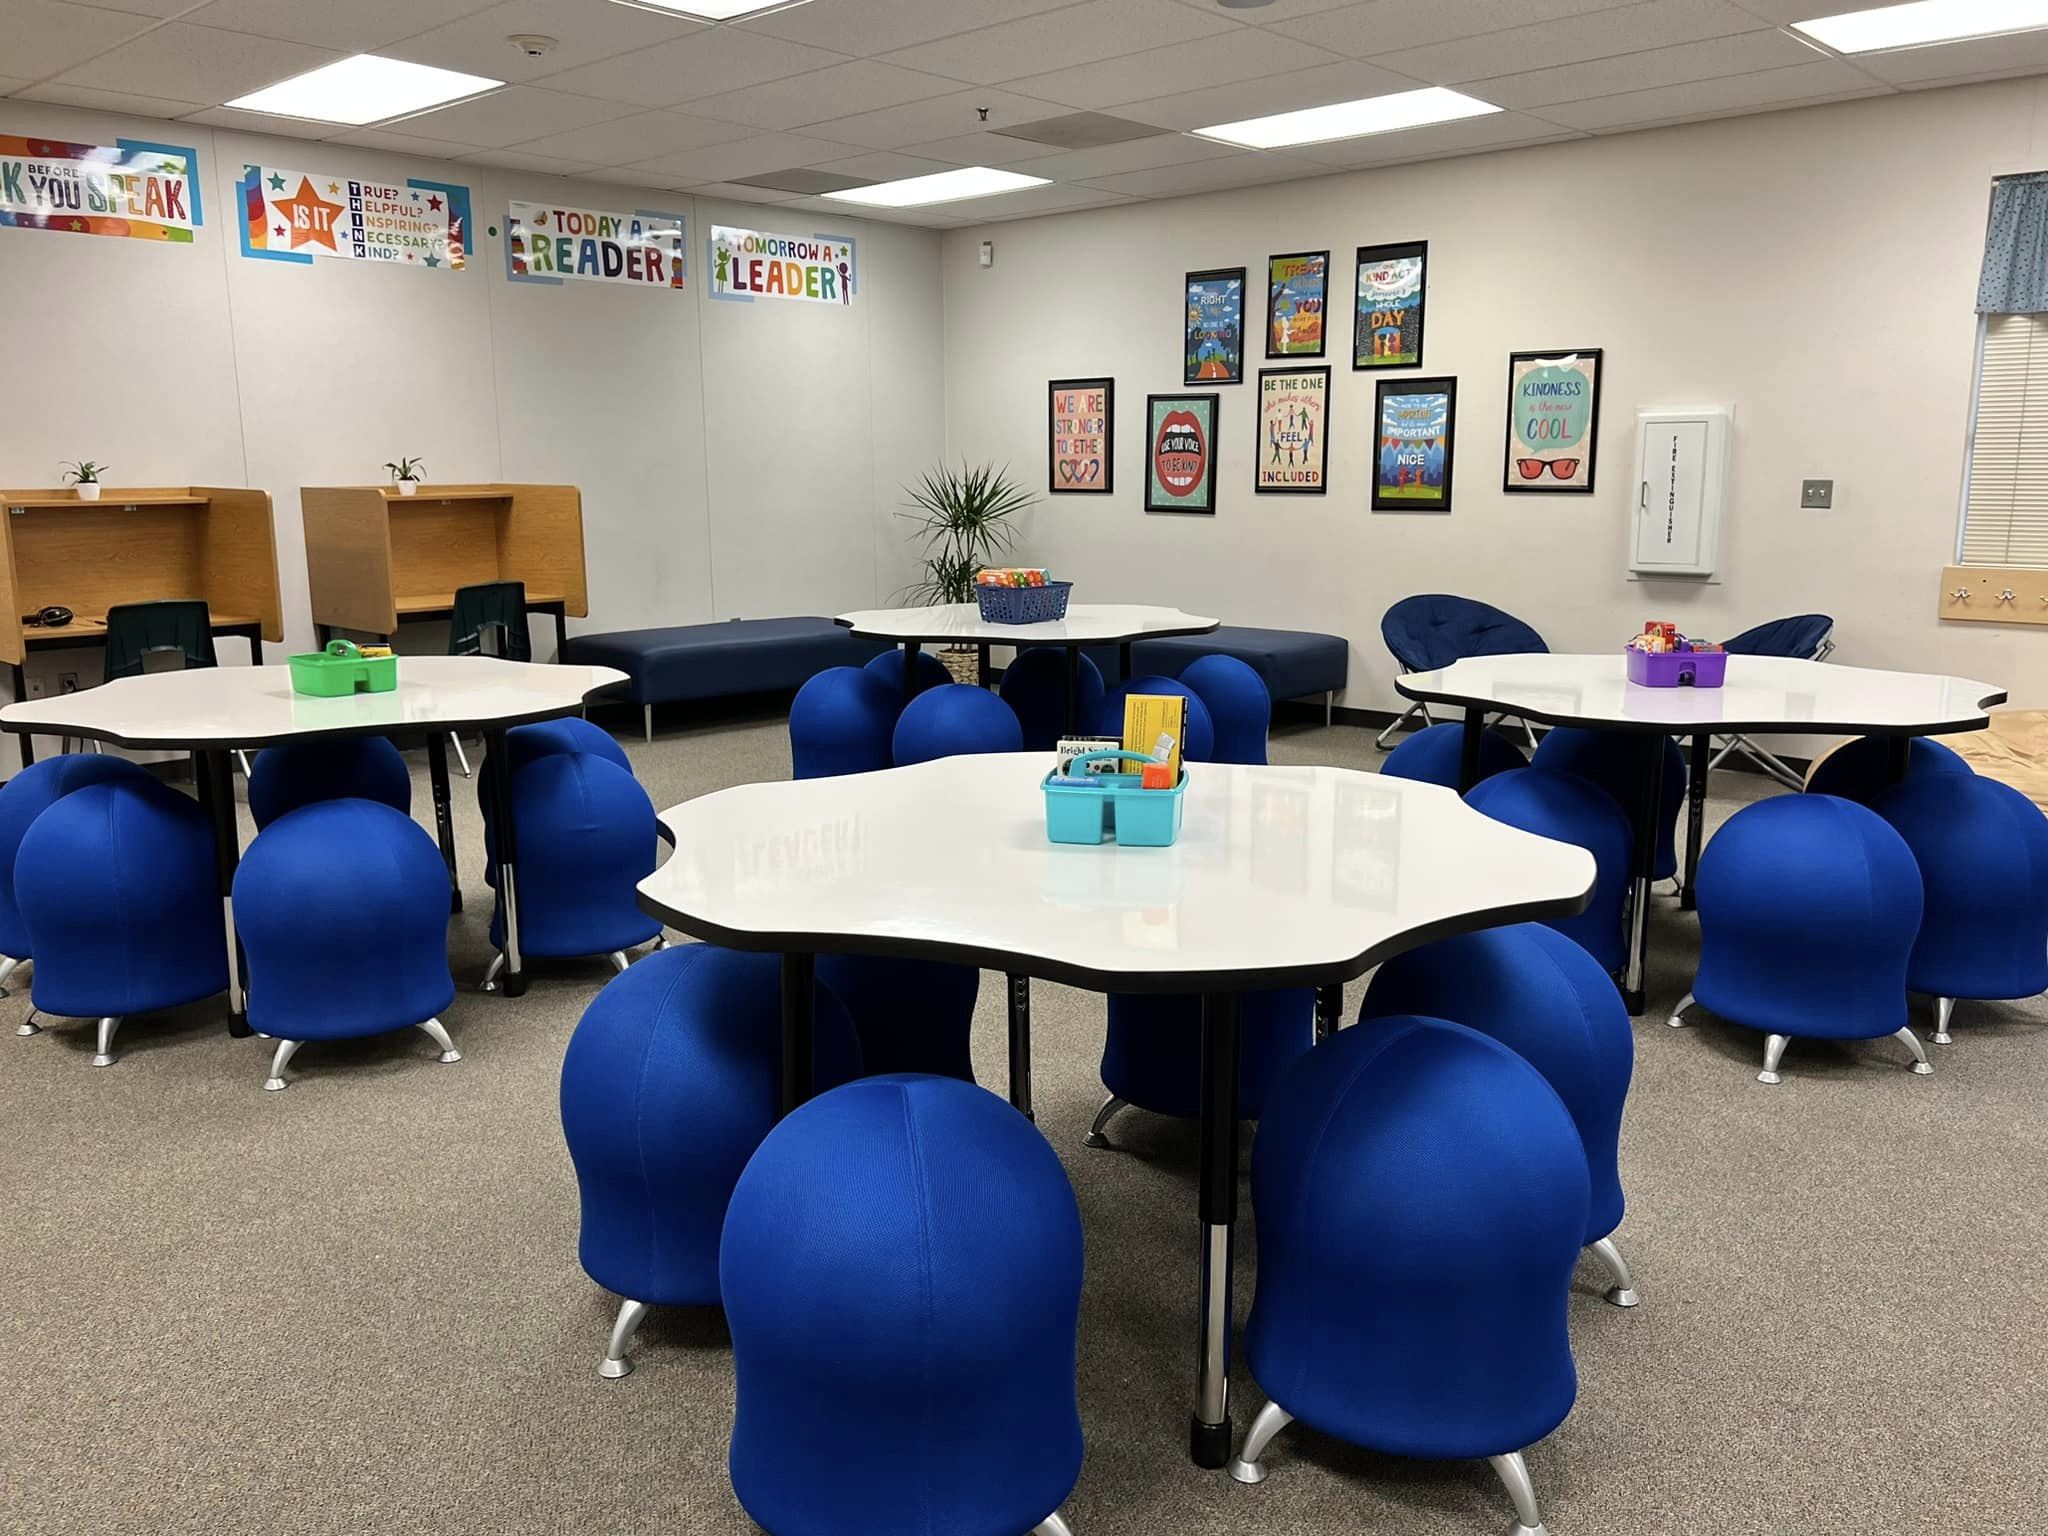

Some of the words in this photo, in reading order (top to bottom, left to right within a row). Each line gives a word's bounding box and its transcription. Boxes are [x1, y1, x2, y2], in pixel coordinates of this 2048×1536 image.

[28, 163, 80, 178] BEFORE
[29, 175, 81, 210] YOU
[87, 172, 187, 220] SPEAK
[292, 203, 311, 230] IS
[313, 205, 331, 232] IT
[552, 209, 622, 239] TODAY
[629, 220, 643, 240] A
[735, 234, 820, 261] TOMORROW
[822, 245, 833, 263] A
[531, 233, 665, 282] READER
[731, 256, 838, 301] LEADER
[1366, 271, 1389, 283] KIND
[1200, 295, 1226, 305] RIGHT
[1371, 309, 1405, 329] DAY
[1264, 379, 1277, 391] BE
[1279, 378, 1298, 390] THE
[1301, 377, 1323, 390] ONE
[1523, 382, 1581, 397] KINDNESS
[1056, 395, 1074, 413] WE
[1079, 394, 1103, 413] ARE
[1056, 418, 1104, 434] STRONGER
[1386, 426, 1441, 438] IMPORTANT
[1527, 418, 1573, 440] COOL
[1184, 437, 1199, 452] VOICE
[1280, 431, 1303, 443] FEEL
[1056, 438, 1103, 454] TOGETHER
[1397, 453, 1425, 466] NICE
[1262, 471, 1320, 483] INCLUDED
